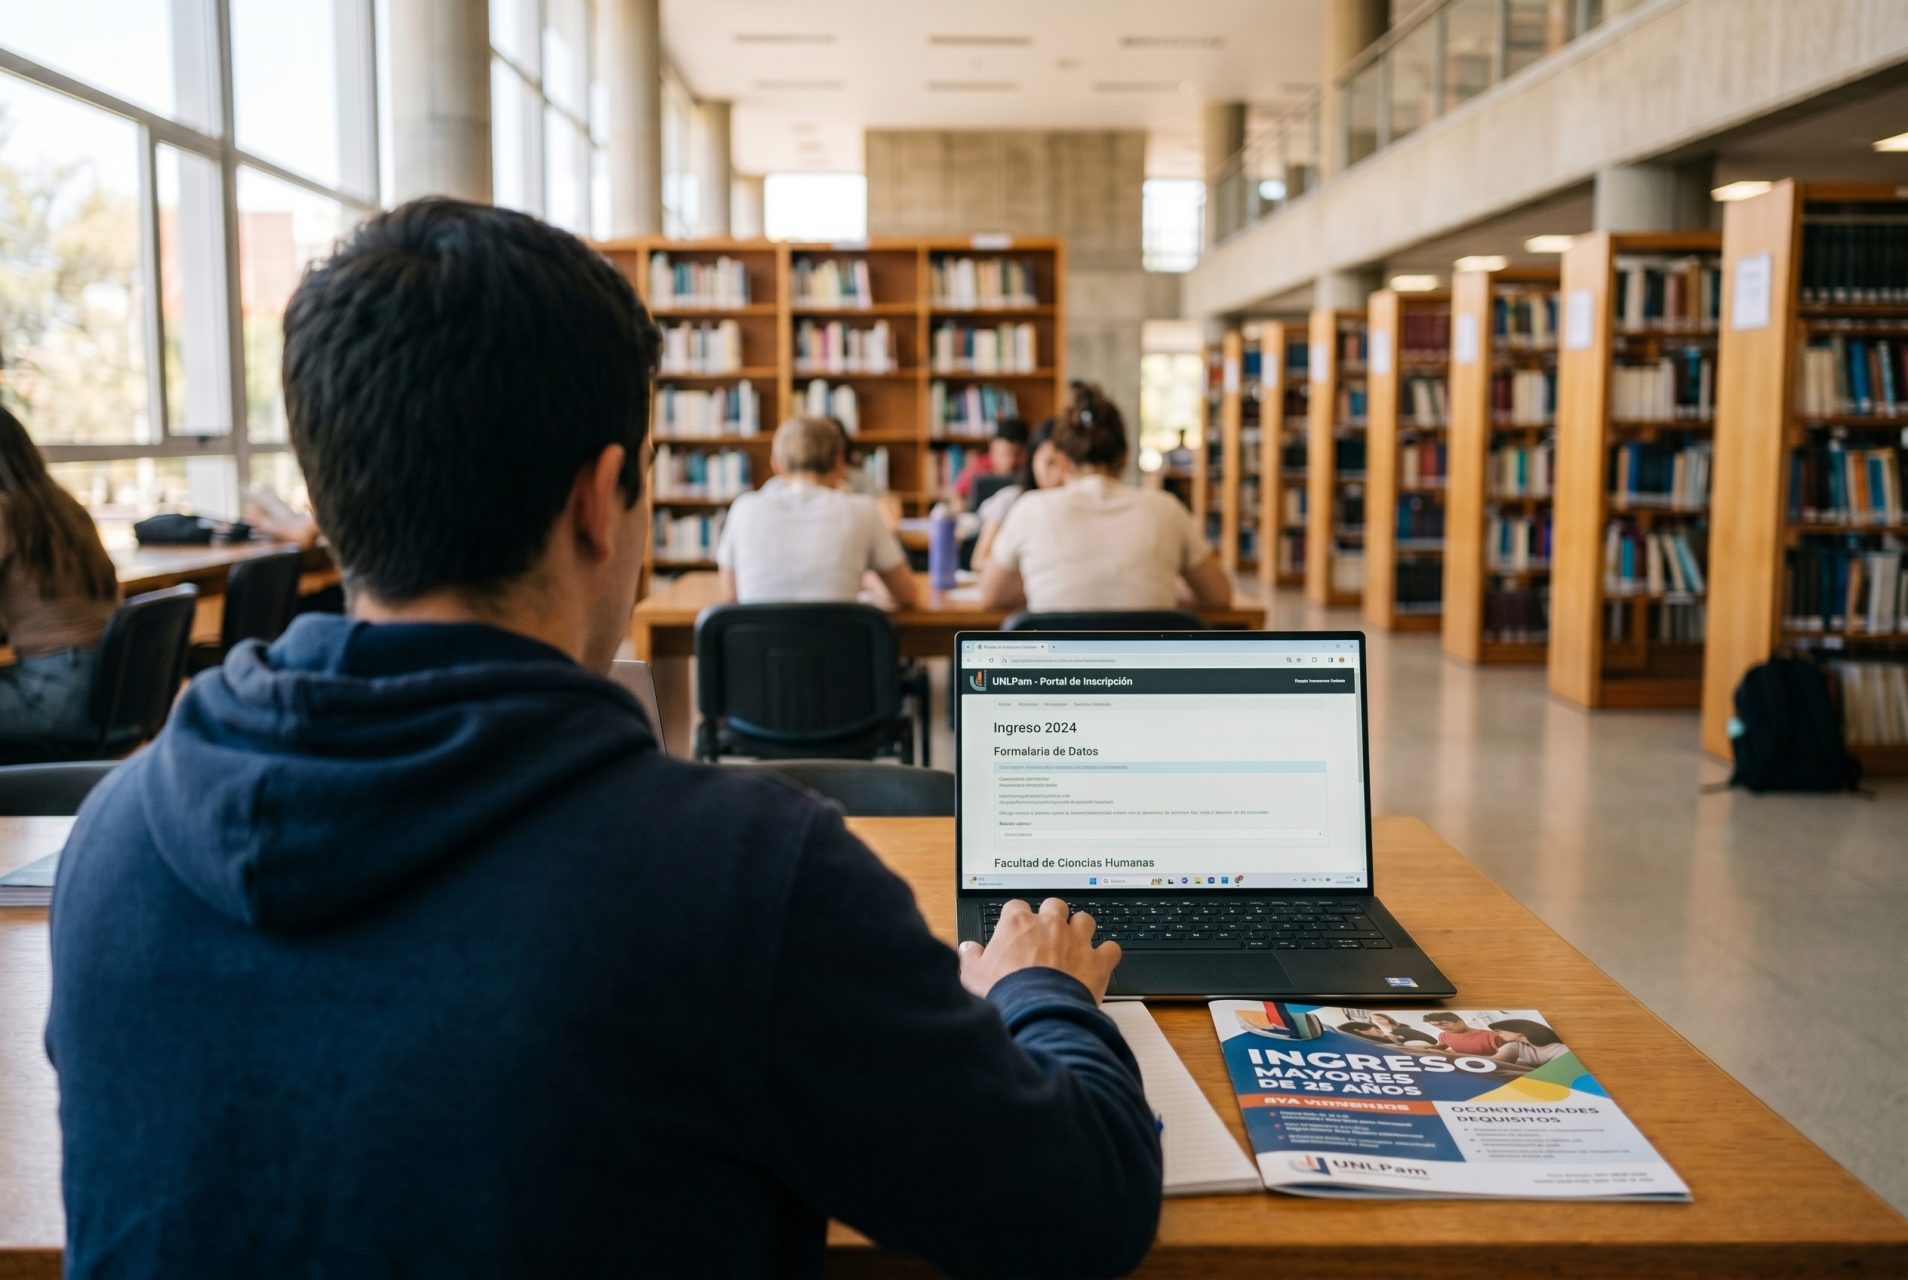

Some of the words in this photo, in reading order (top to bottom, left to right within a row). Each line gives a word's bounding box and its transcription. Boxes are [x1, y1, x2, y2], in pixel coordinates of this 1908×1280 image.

[992, 677, 1032, 686] UNLPam
[1040, 677, 1067, 686] Portal
[1070, 677, 1081, 686] de
[1083, 676, 1133, 688] Inscripción
[994, 722, 1041, 736] Ingreso
[1045, 722, 1077, 733] 2024
[1053, 746, 1066, 756] de
[1068, 746, 1099, 756] Datos
[994, 858, 1039, 868] Facultad
[1042, 858, 1055, 868] de
[1105, 858, 1155, 868] Humanas
[1247, 1048, 1497, 1073] INGRESO
[1254, 1067, 1414, 1084] MAYORES
[1258, 1079, 1296, 1090] DE
[1304, 1081, 1334, 1092] 25
[1342, 1083, 1422, 1096] AÑOS
[1333, 1159, 1428, 1177] UNLPam
